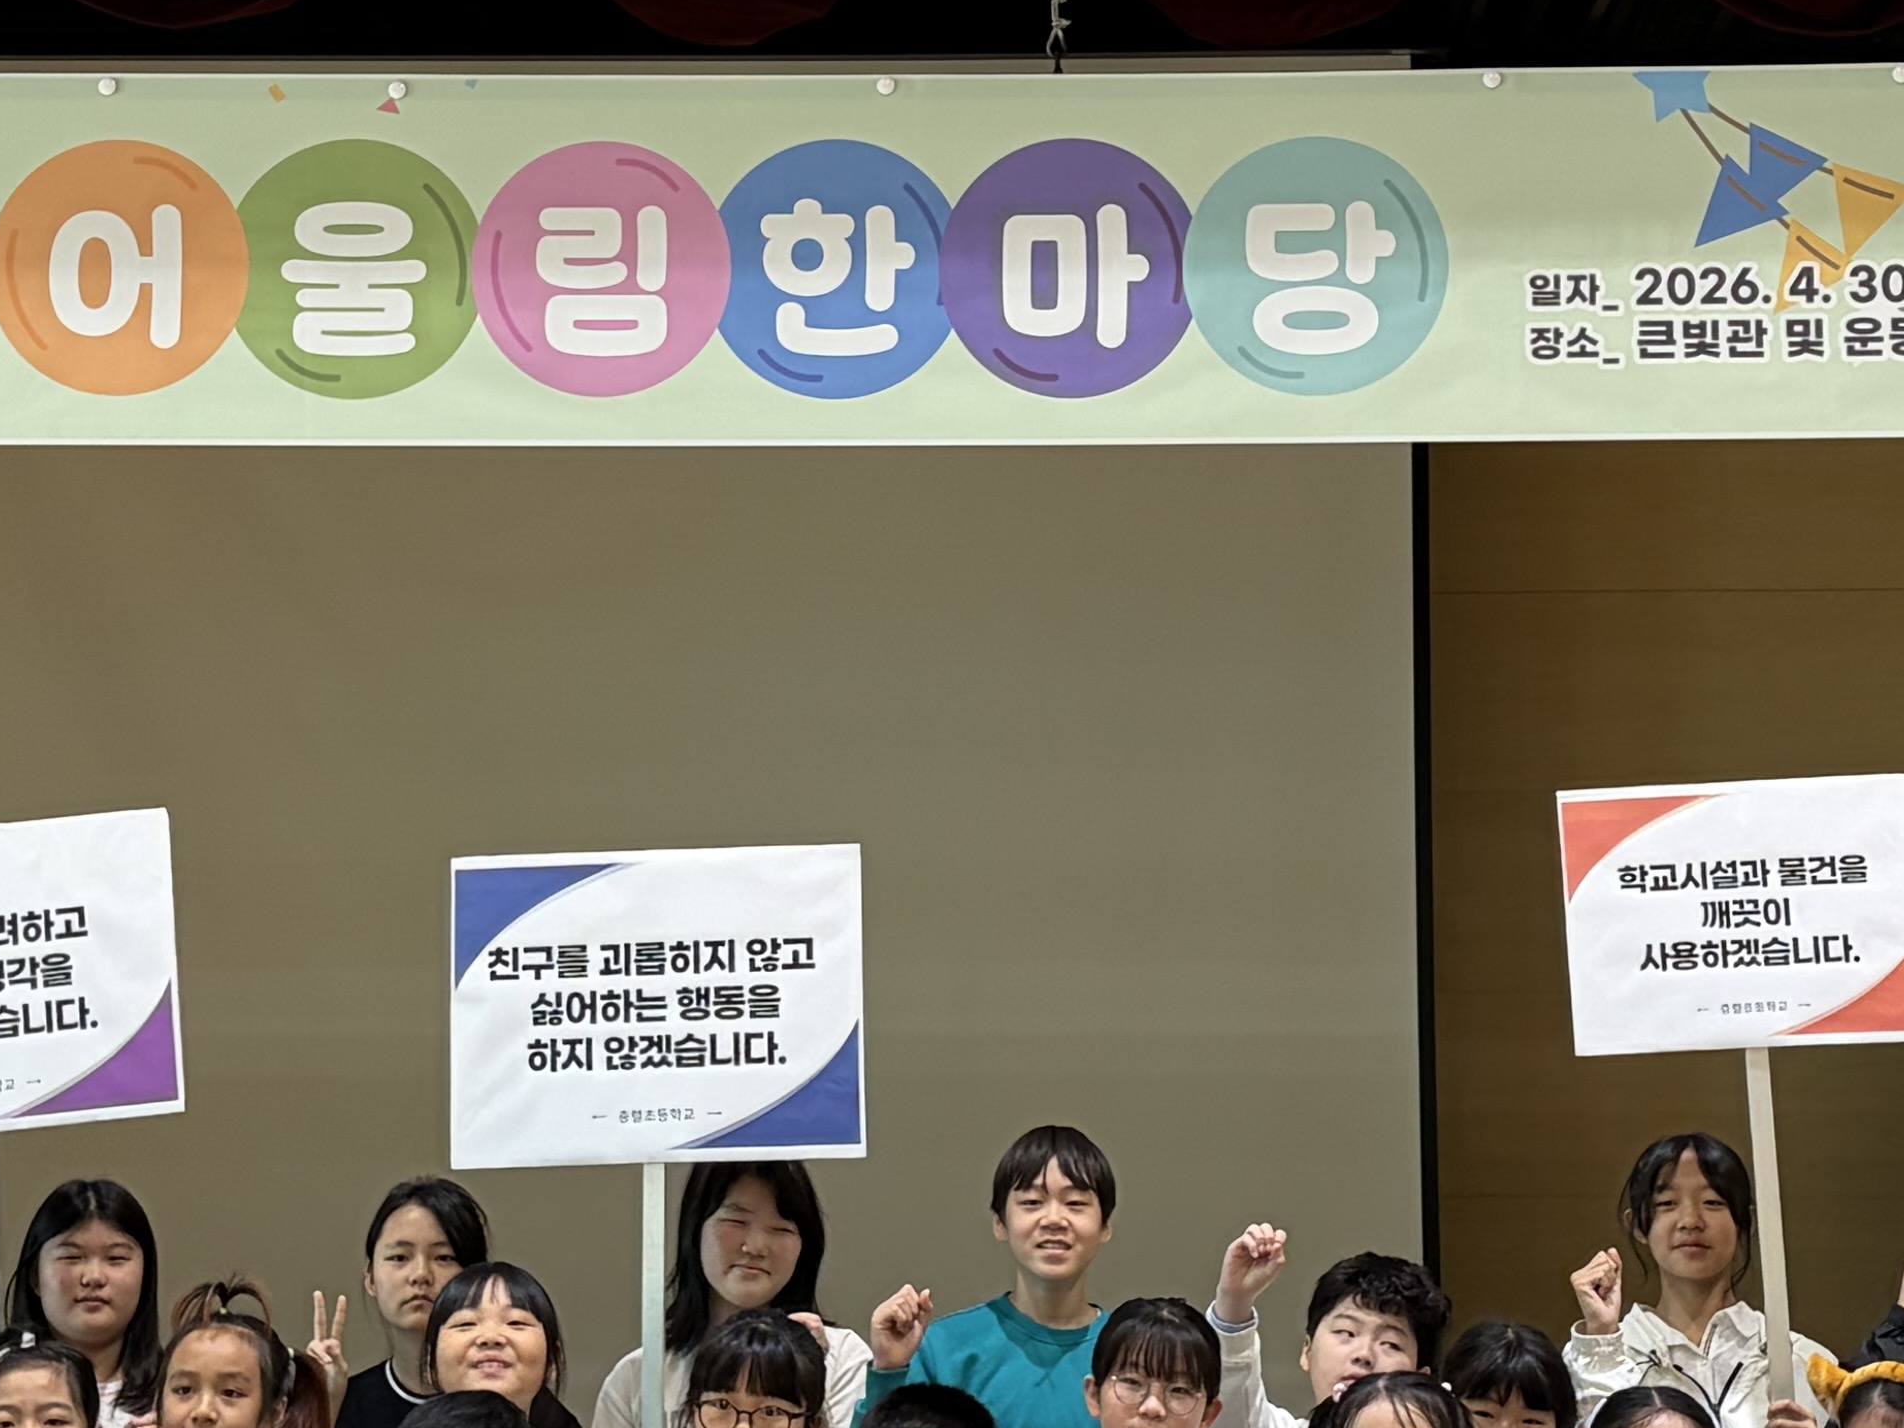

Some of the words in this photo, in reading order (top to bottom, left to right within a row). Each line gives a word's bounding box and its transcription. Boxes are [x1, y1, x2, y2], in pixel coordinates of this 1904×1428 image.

[1529, 273, 1619, 310] 일자_
[1635, 267, 1772, 305] 2026.
[1790, 267, 1832, 303] 4.
[1530, 325, 1619, 364] 장소_
[1637, 320, 1766, 359] 큰빛관
[1786, 318, 1823, 357] 및
[1617, 858, 1771, 894] 학교시설과
[1777, 854, 1868, 886] 물건을
[1700, 897, 1791, 929] 깨끗이
[487, 943, 589, 982] 친구를
[599, 938, 736, 979] 괴롭히지
[745, 937, 816, 973] 않고
[1639, 934, 1861, 972] 사용하겠습니다.
[531, 989, 668, 1027] 싫어하는
[676, 984, 781, 1021] 행동을
[527, 1037, 594, 1073] 하지
[603, 1031, 788, 1070] 않겠습니다.
